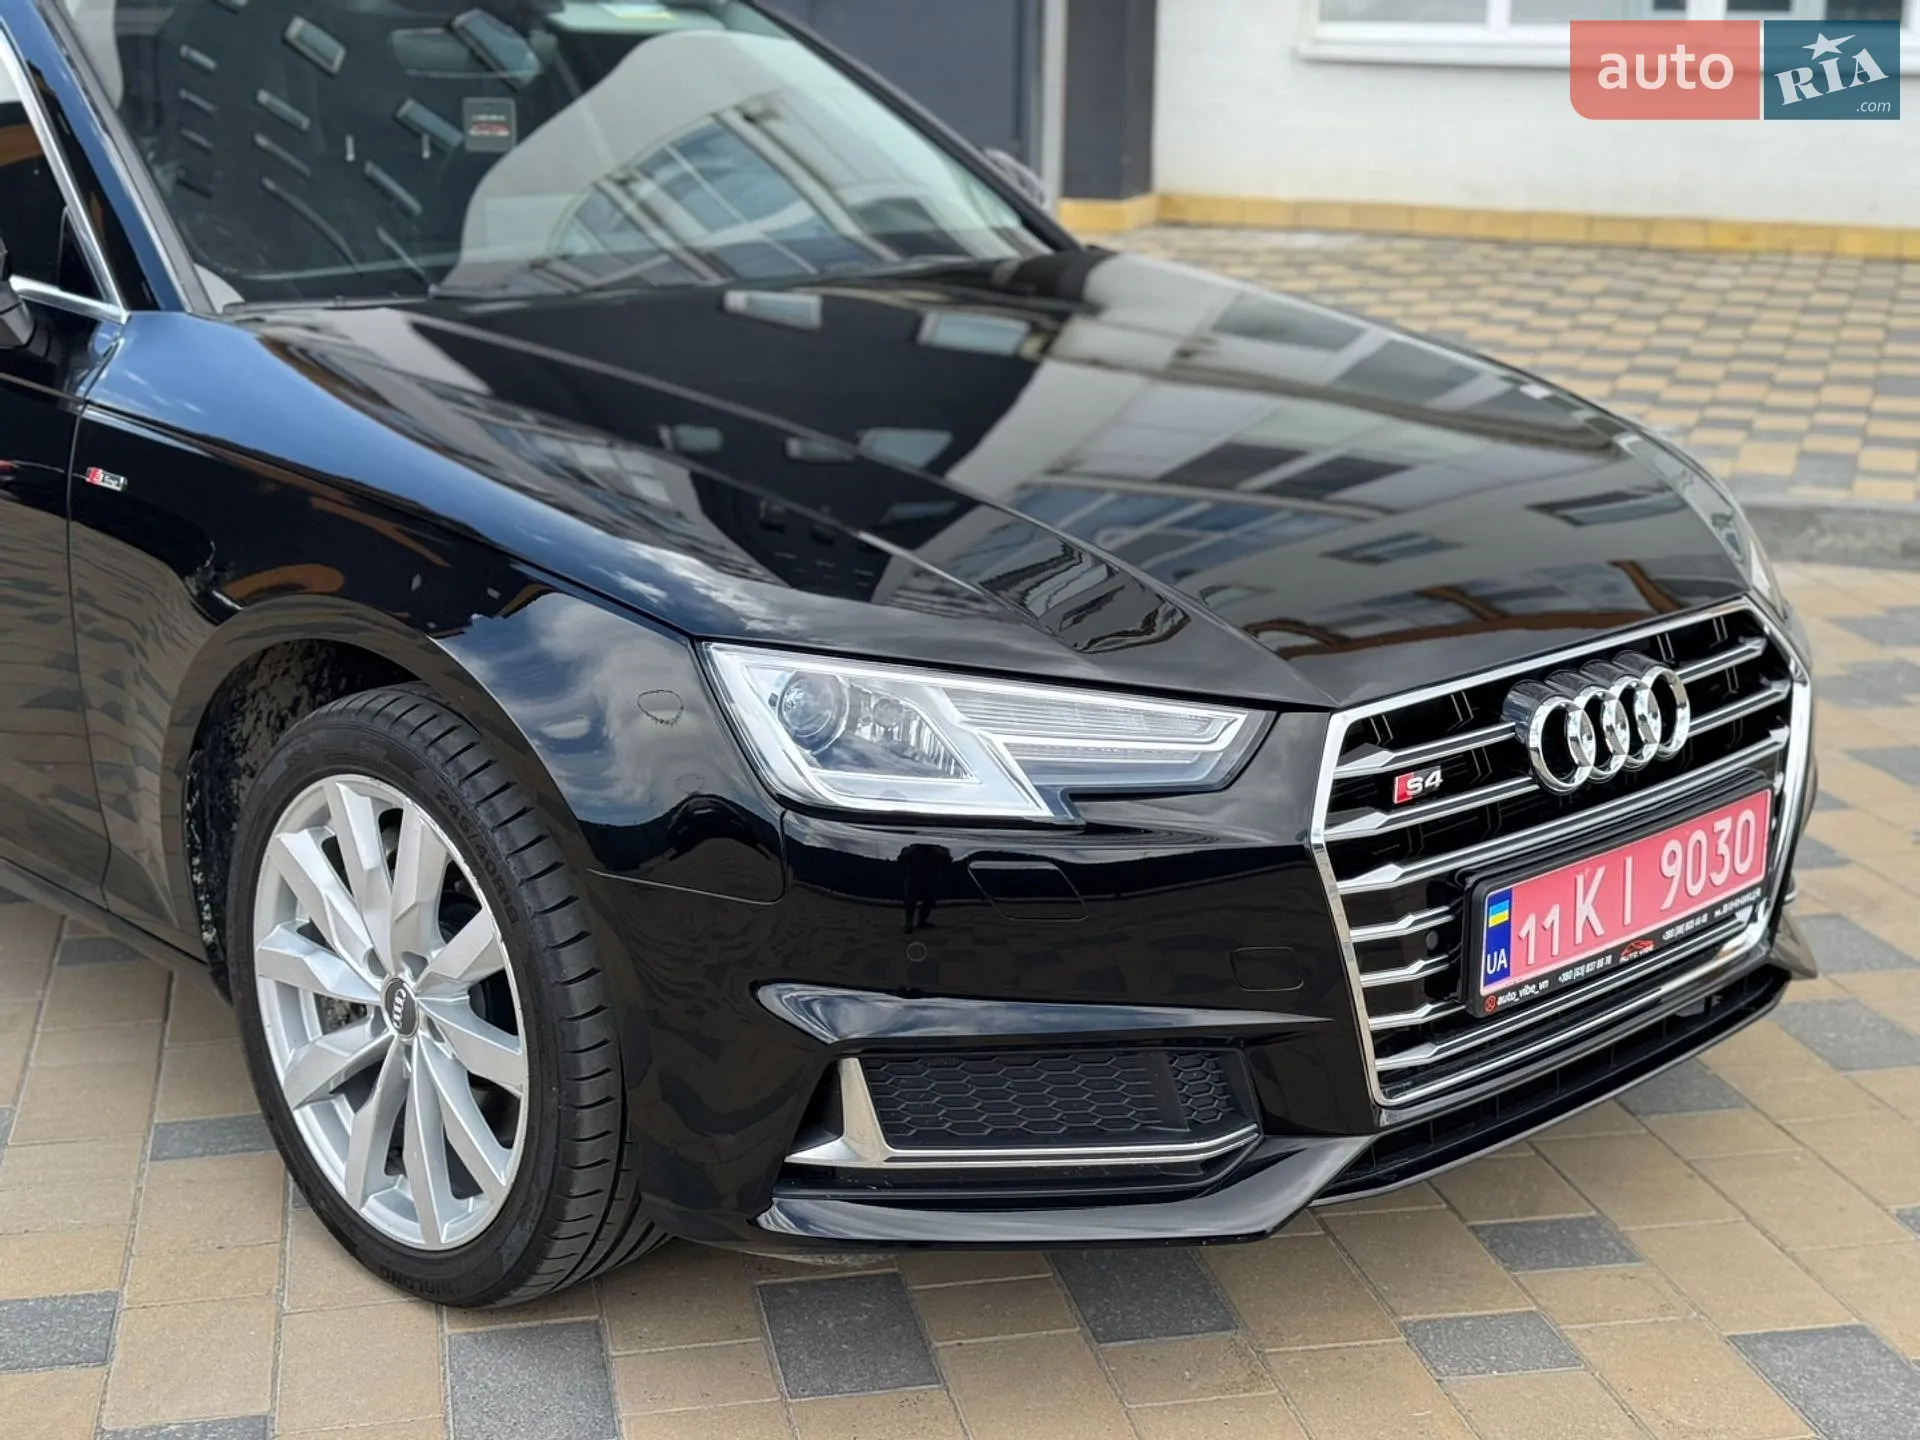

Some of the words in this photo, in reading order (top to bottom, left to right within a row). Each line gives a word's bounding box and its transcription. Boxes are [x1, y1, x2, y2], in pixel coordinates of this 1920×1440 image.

[1406, 768, 1444, 796] S4
[1659, 808, 1756, 911] 9030
[1486, 948, 1508, 975] UA
